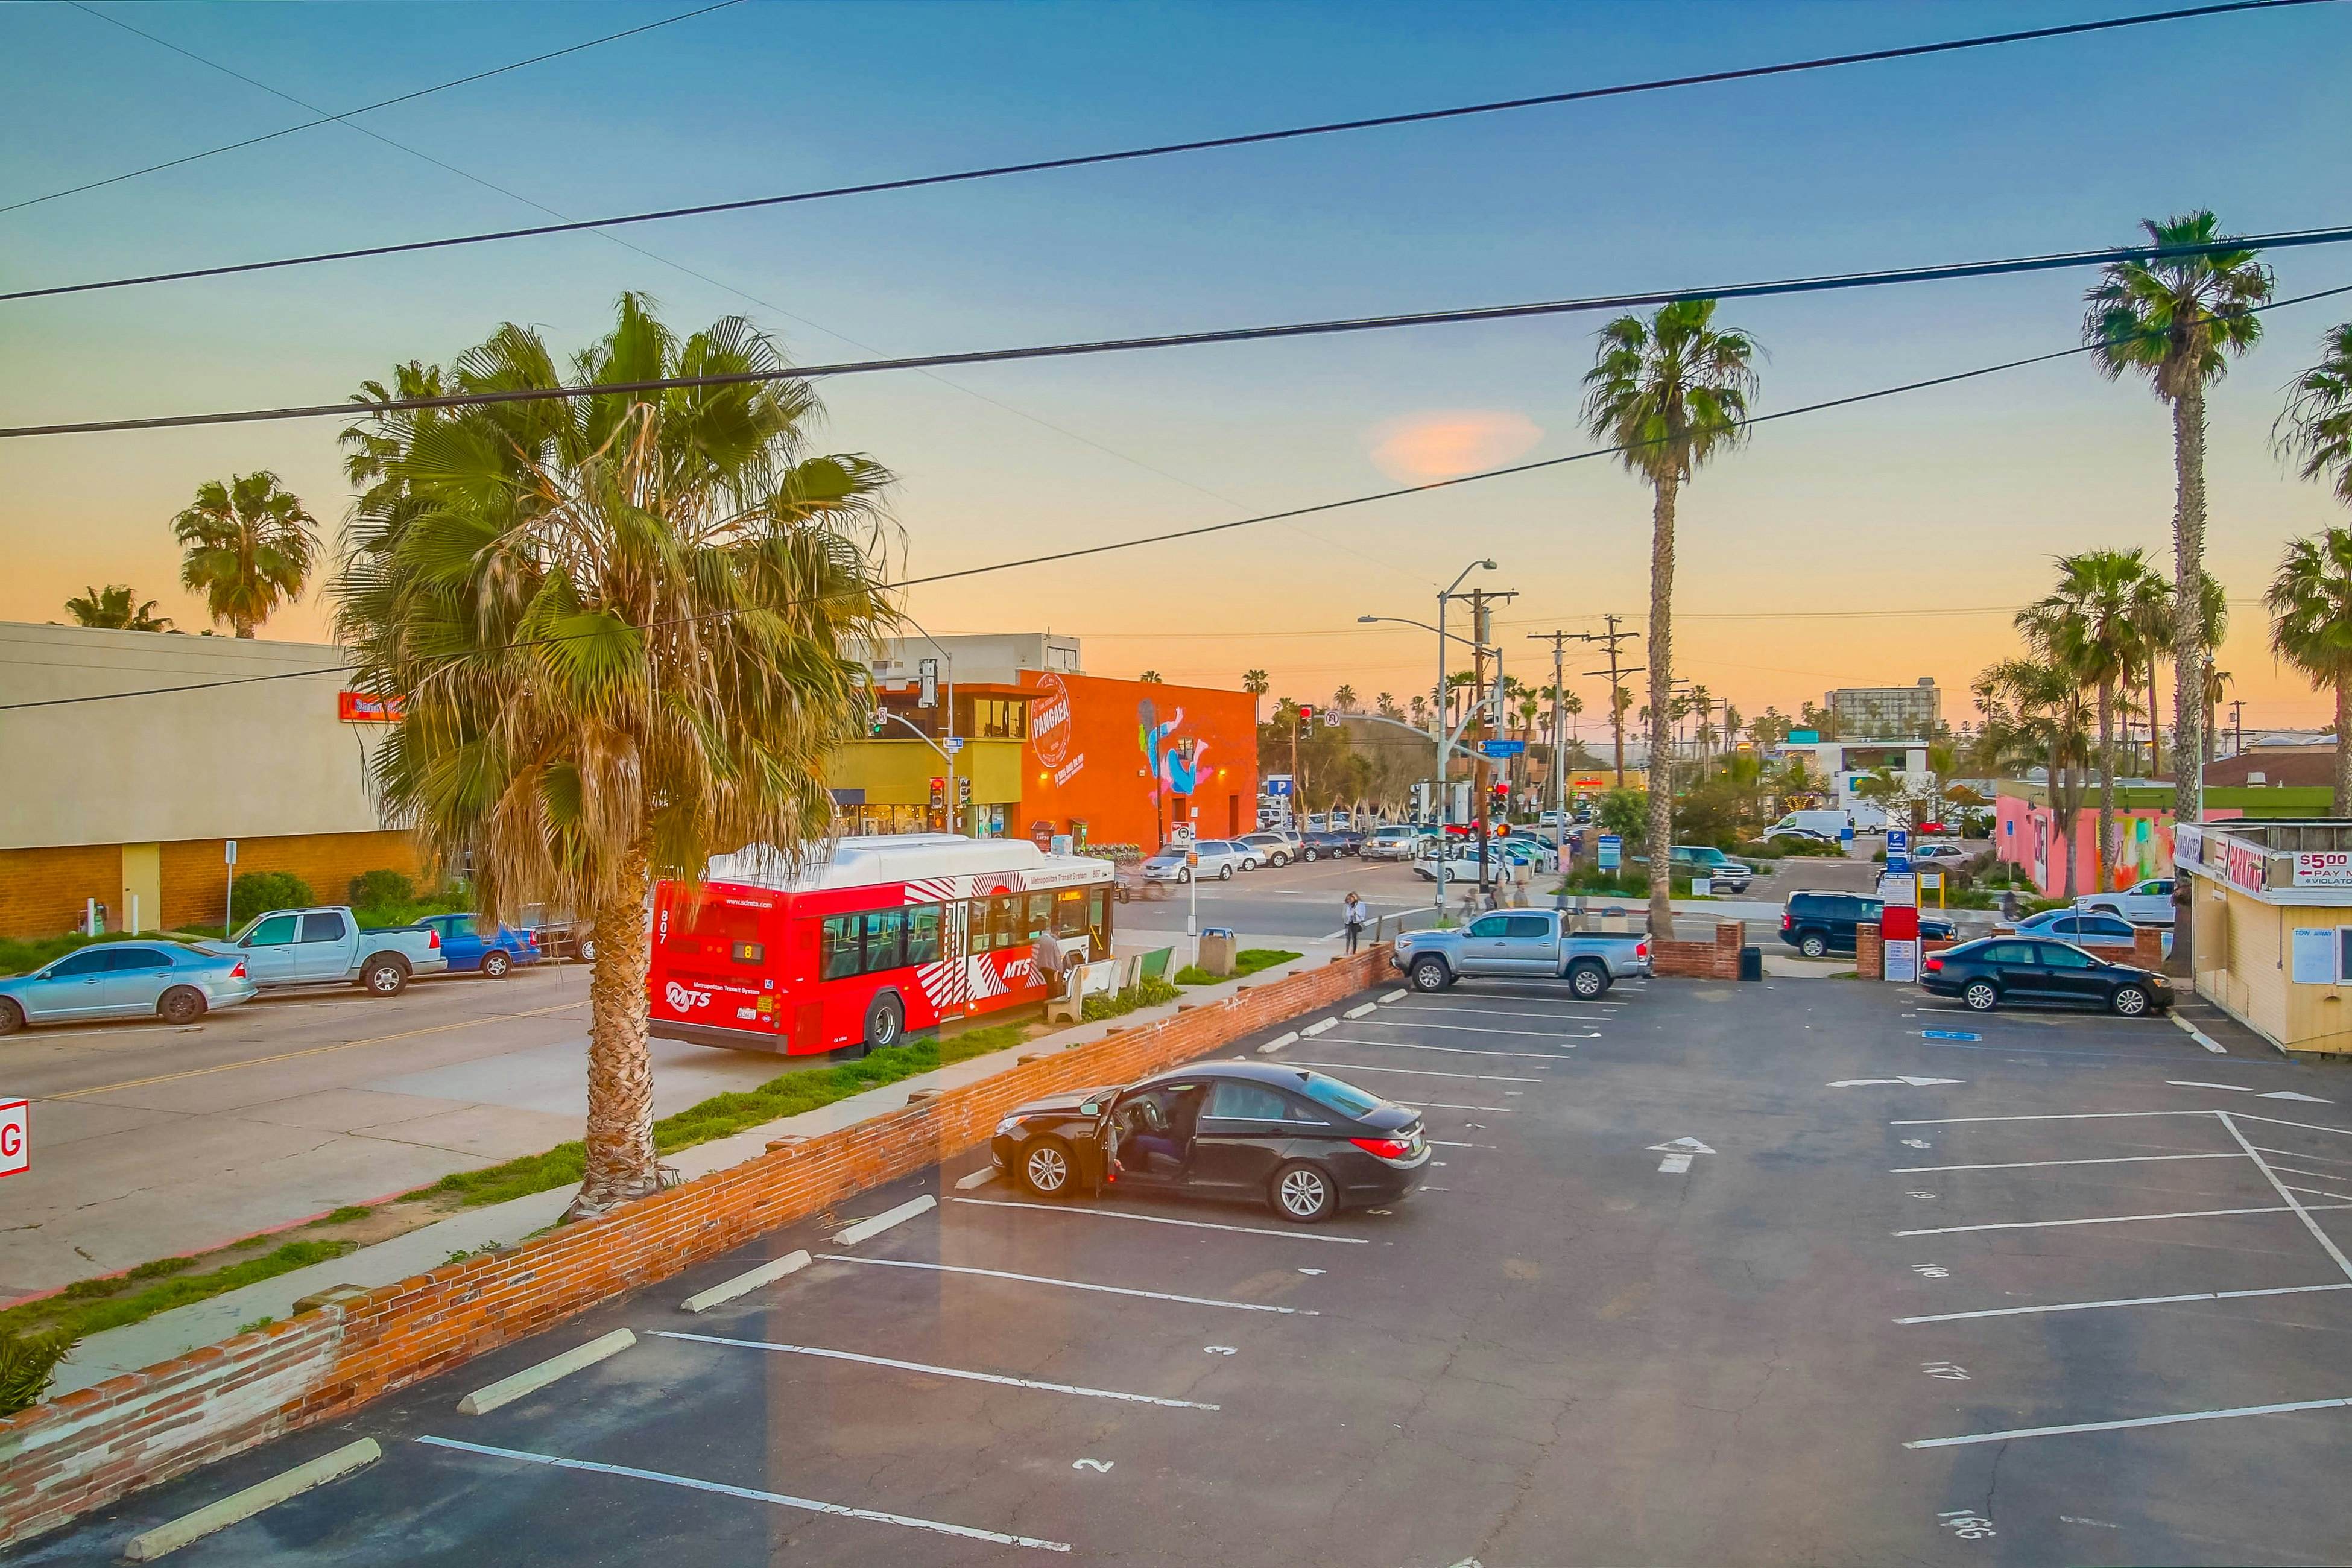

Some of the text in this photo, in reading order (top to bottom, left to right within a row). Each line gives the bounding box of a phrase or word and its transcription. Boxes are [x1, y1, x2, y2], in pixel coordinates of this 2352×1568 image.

[1033, 699, 1069, 739] PANGAEA
[1277, 781, 1286, 792] P
[1031, 876, 1057, 884] Metropolitan
[1058, 874, 1072, 882] Transit
[1072, 872, 1087, 881] System
[2230, 845, 2262, 894] PARKING
[726, 898, 773, 908] www.sdmts.com
[660, 910, 668, 944] 807
[744, 945, 752, 959] 8
[1002, 958, 1031, 980] MTS
[693, 982, 724, 991] Metropolitan
[666, 988, 712, 1007] MTS
[1, 1123, 21, 1157] G
[1072, 1458, 1114, 1473] 2
